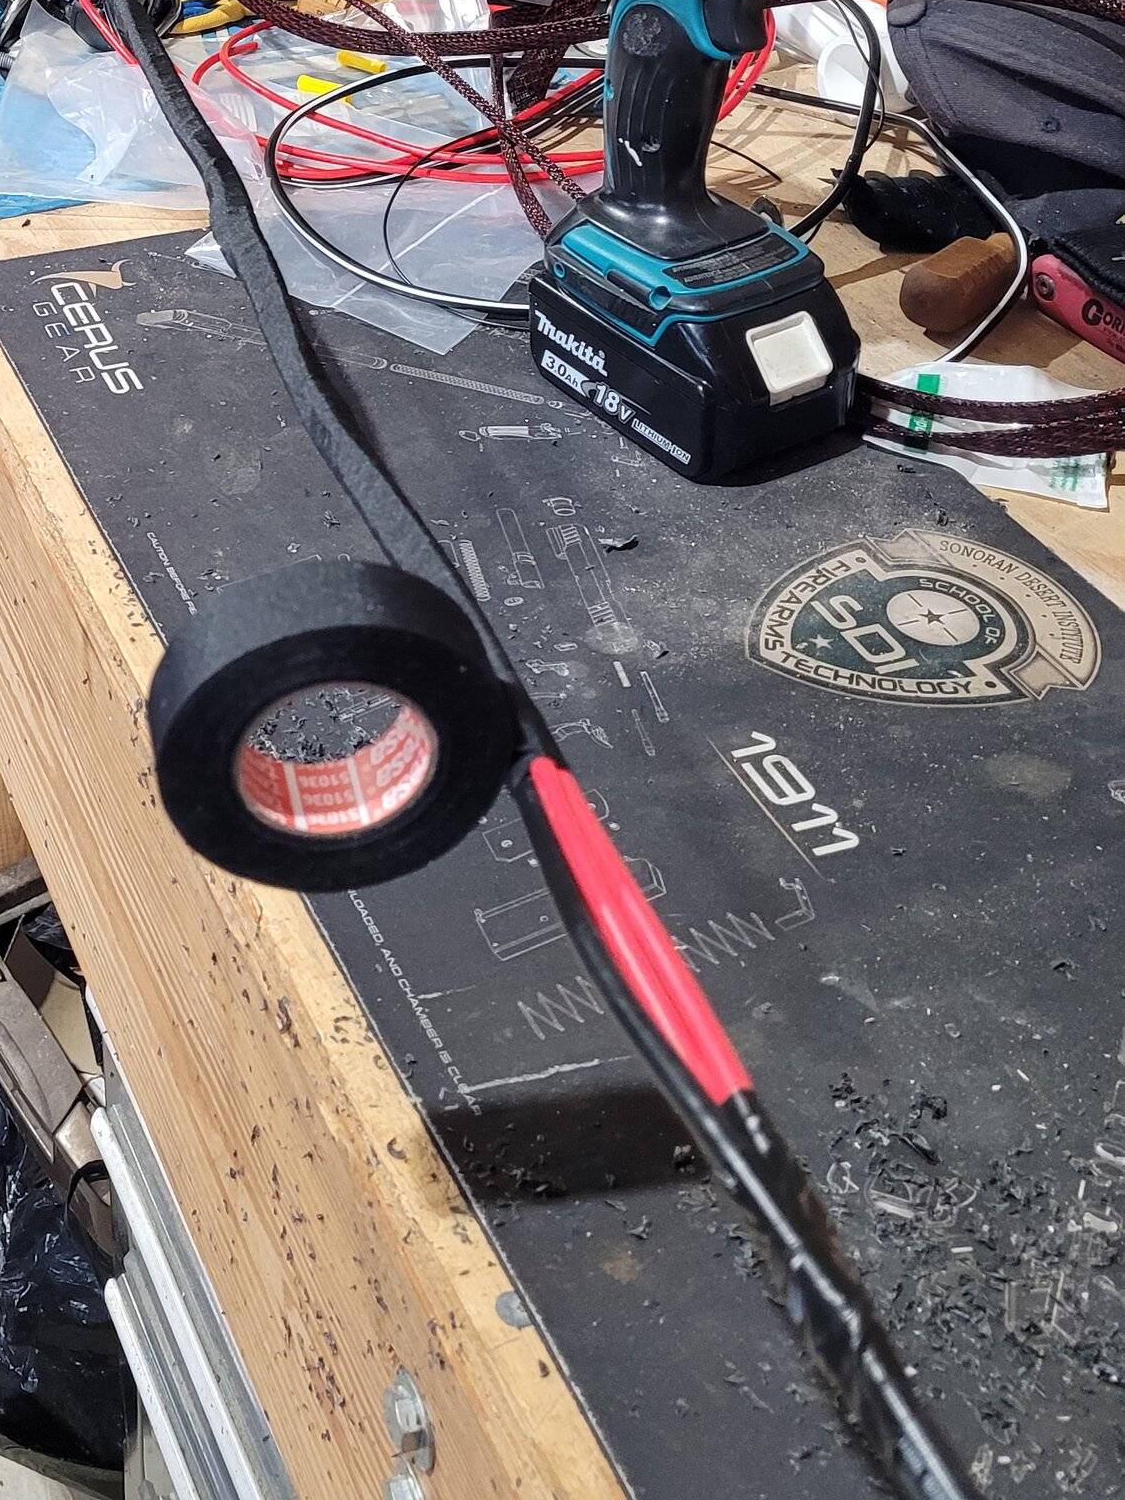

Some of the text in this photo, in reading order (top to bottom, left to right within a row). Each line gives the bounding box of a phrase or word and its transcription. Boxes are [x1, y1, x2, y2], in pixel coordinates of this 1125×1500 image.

[32, 301, 96, 383] GEAR
[50, 282, 144, 394] CERUS
[146, 531, 171, 567] CAUTION
[165, 566, 190, 602] BEFORE
[763, 559, 852, 652] FIREARMS
[939, 539, 1085, 666] SONORAN DESERT INSTITUTE
[810, 594, 920, 675] SDI
[918, 578, 1003, 647] SCHOOL OF
[780, 651, 975, 696] TECHNOLOGY
[729, 730, 861, 857] 1911
[381, 948, 403, 978] AND
[399, 978, 444, 1049] CHAMBER
[438, 1050, 453, 1065] IS
[448, 1066, 482, 1117] CLEAR
